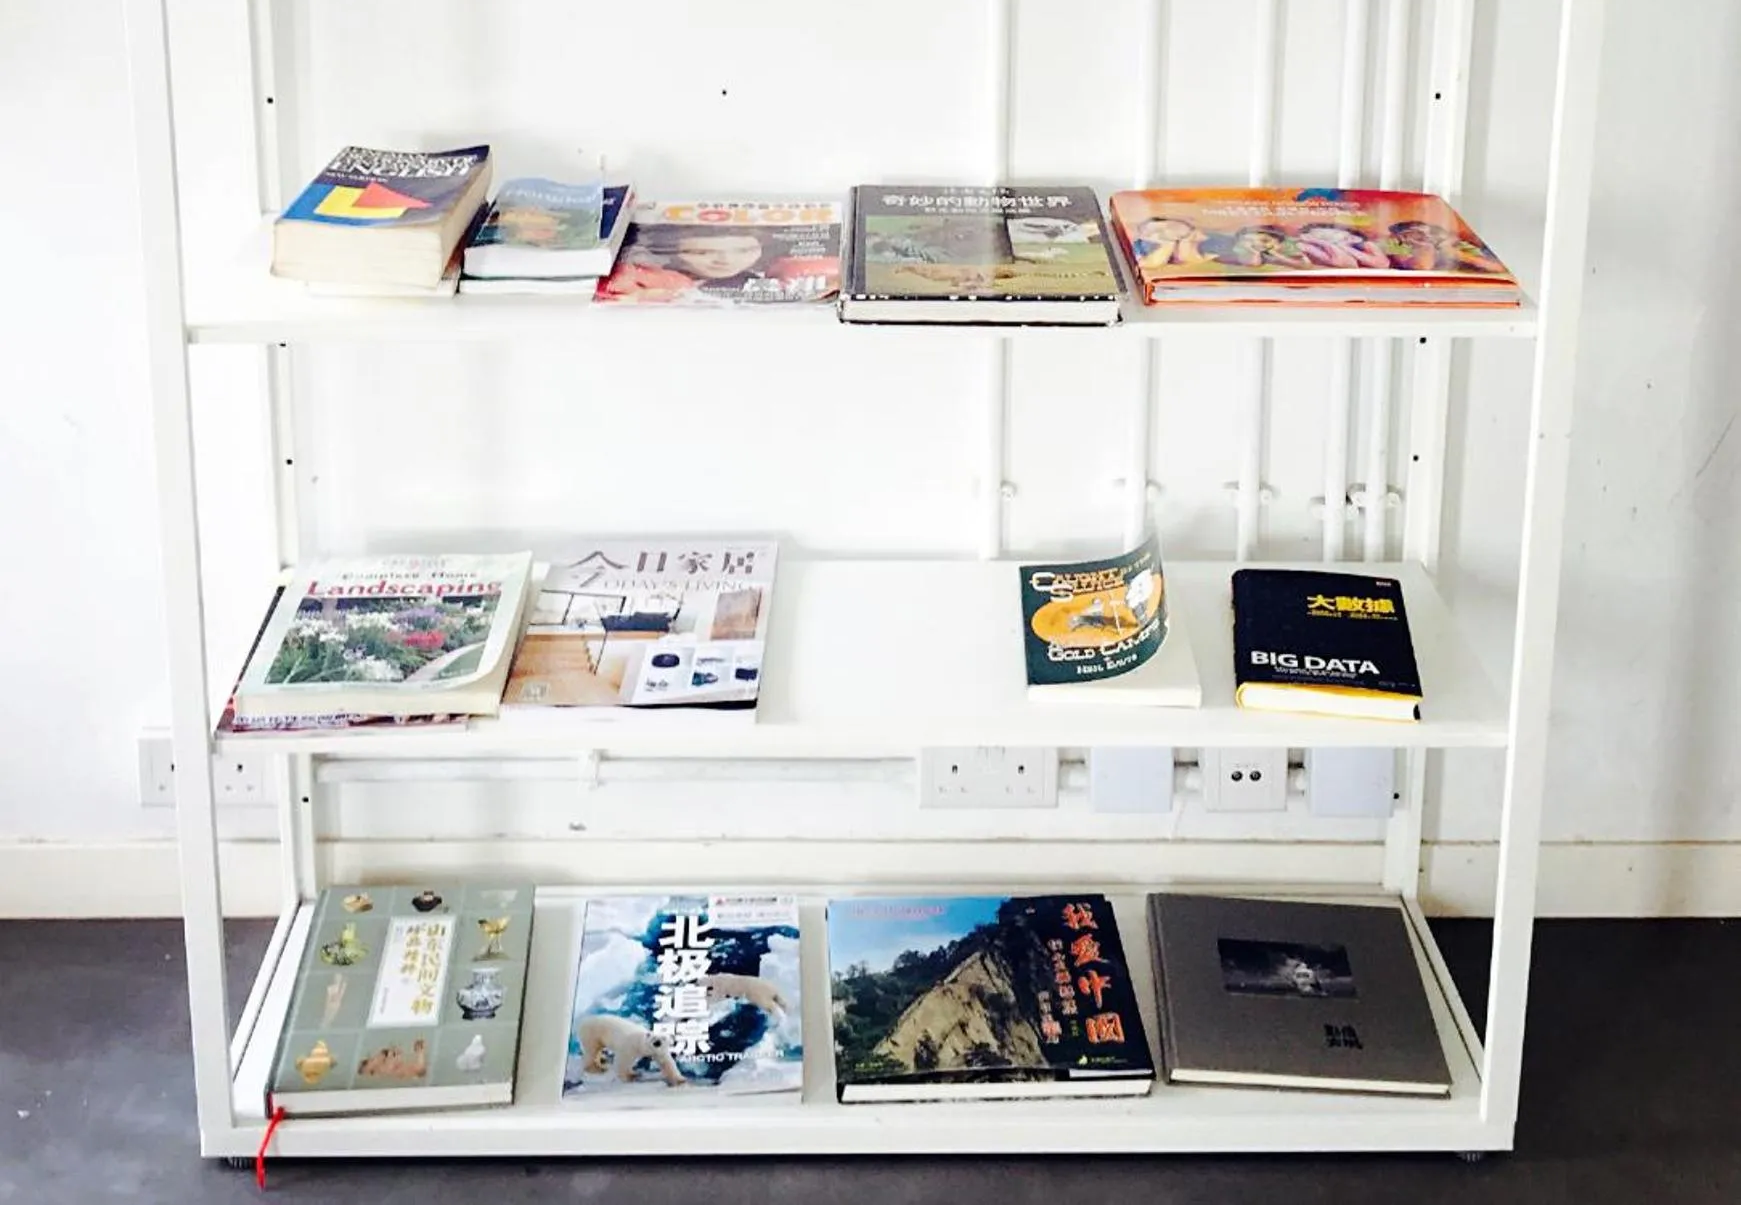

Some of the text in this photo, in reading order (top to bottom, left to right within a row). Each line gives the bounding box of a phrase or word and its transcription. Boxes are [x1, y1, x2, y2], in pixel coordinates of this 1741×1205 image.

[306, 580, 503, 597] Landscaping
[1047, 644, 1096, 662] GOLD
[1250, 650, 1299, 669] BIG
[1303, 655, 1381, 675] DATA
